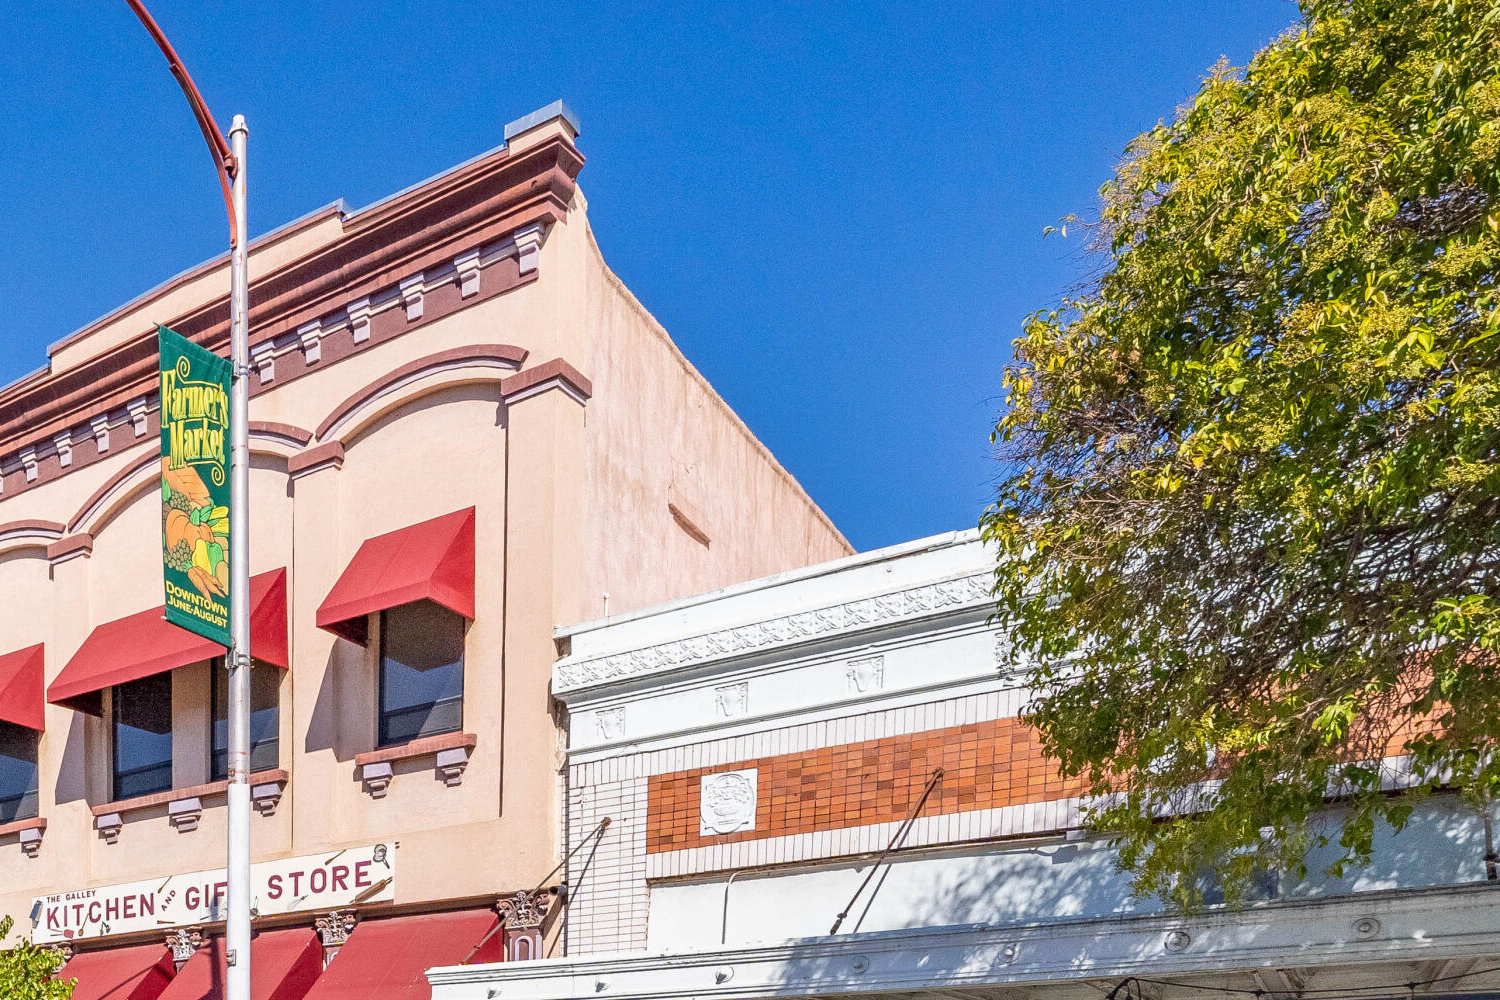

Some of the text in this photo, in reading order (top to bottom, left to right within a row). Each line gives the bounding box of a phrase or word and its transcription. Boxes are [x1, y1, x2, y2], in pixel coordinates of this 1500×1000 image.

[169, 417, 226, 471] Market
[165, 580, 228, 617] DOWNTOWN
[46, 859, 373, 930] KITCHEN AND GIF STORE
[46, 890, 97, 903] THE GALLEY
